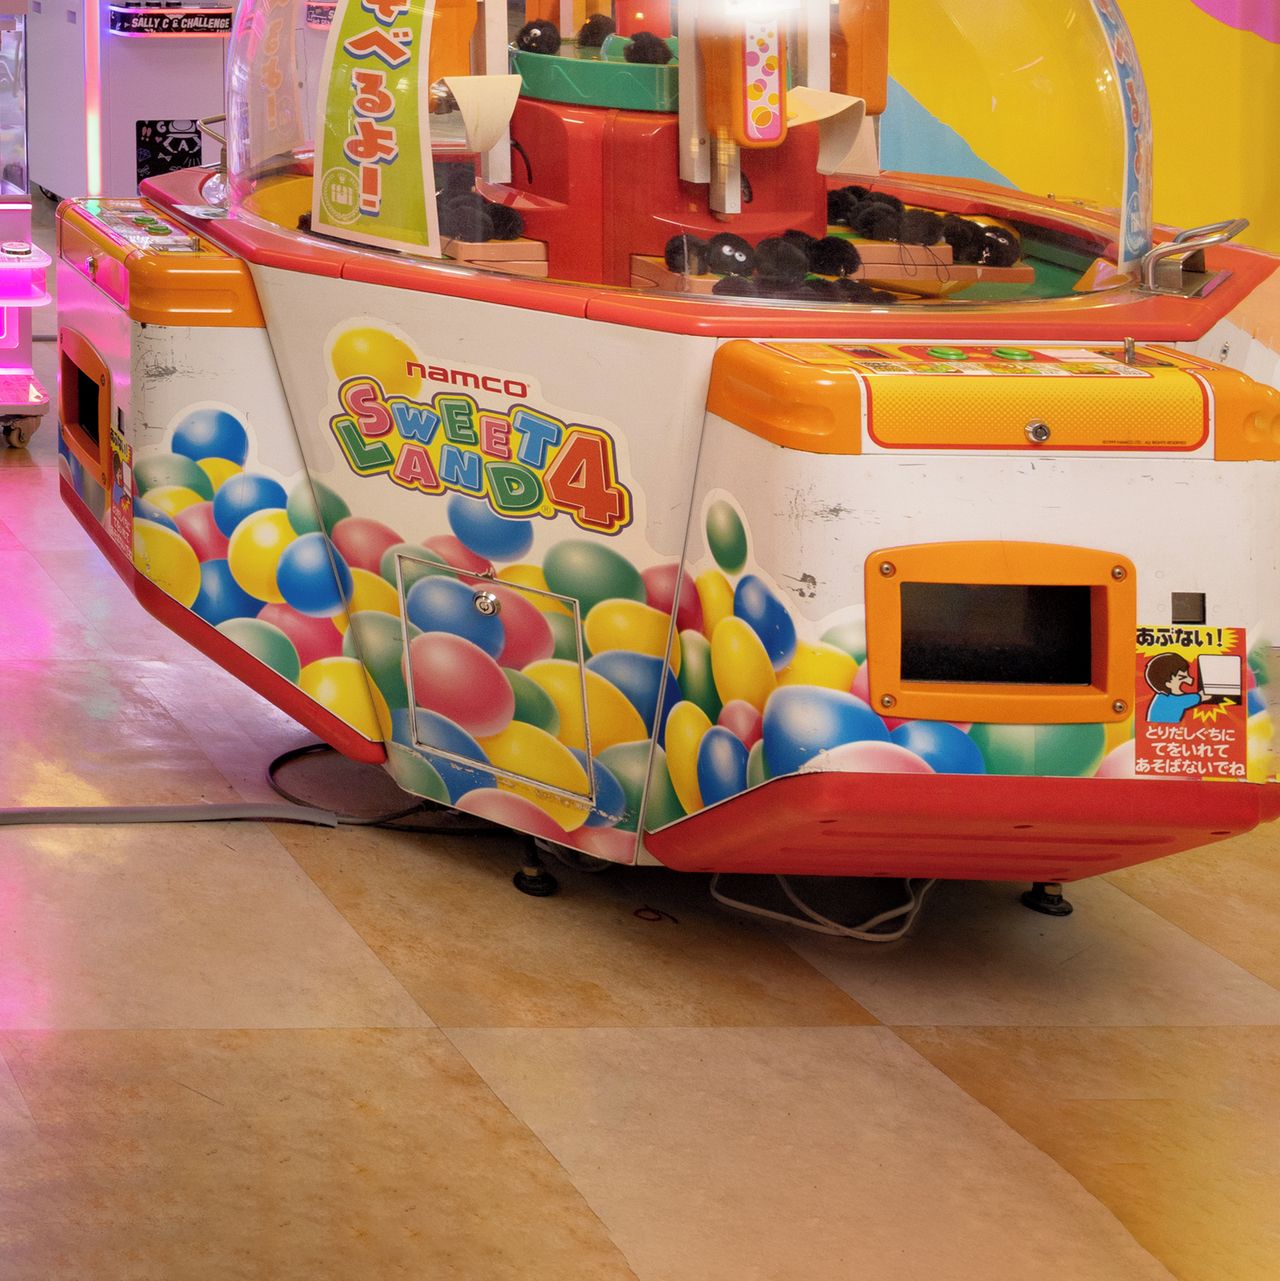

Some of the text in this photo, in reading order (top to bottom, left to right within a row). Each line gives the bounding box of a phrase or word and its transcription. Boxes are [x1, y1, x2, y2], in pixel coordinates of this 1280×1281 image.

[131, 17, 160, 29] SALLY
[162, 17, 169, 29] C
[180, 17, 230, 29] CHALLENGE
[405, 360, 528, 400] namco
[336, 380, 562, 469] SWEET
[332, 418, 628, 529] LAND 4
[1135, 627, 1223, 650] あぶない!
[1144, 726, 1236, 742] とりだしぐちに
[1151, 742, 1229, 758] てをいれて
[1135, 757, 1247, 776] あそばないでね
